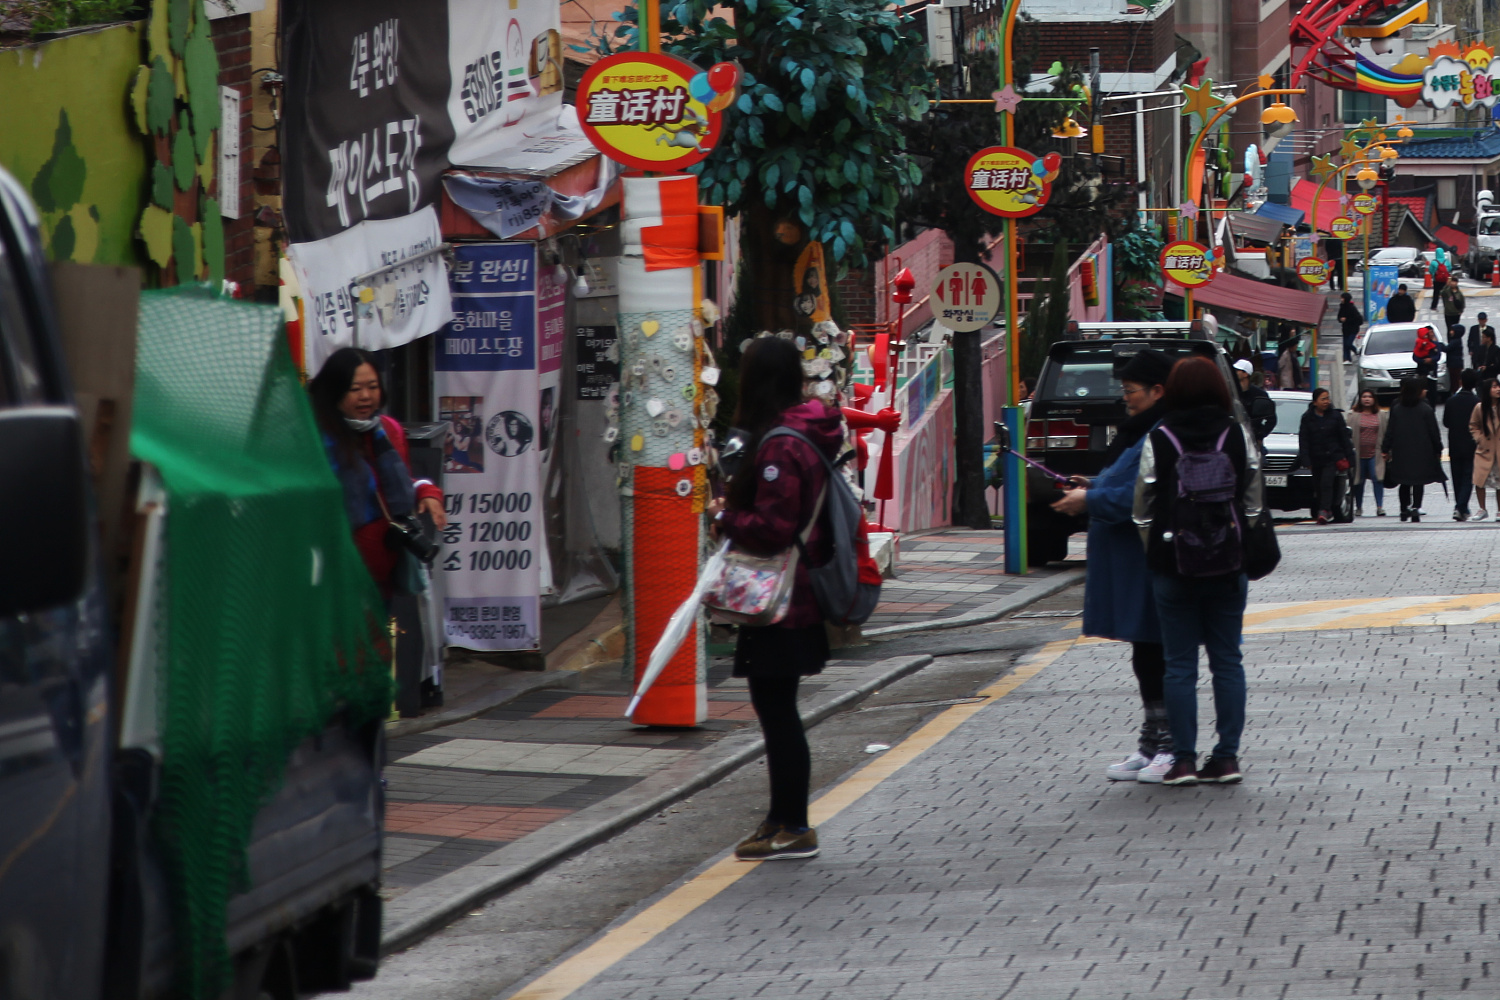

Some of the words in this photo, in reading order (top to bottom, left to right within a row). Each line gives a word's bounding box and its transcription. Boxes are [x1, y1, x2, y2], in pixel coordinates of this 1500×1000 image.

[350, 31, 369, 98] 2분
[372, 18, 400, 91] 완성!
[586, 88, 685, 123] 童话村
[326, 114, 422, 228] 페이스도장
[970, 168, 1030, 190] 童话村
[450, 260, 475, 284] 분
[1163, 255, 1205, 270] 童话村
[451, 310, 513, 332] 동화마을
[942, 309, 974, 322] 화장실
[444, 336, 524, 358] 페이스도장
[469, 492, 532, 514] 15000
[443, 522, 463, 544] 중
[469, 520, 532, 543] 12000
[443, 550, 462, 571] 소
[469, 549, 532, 571] 10000
